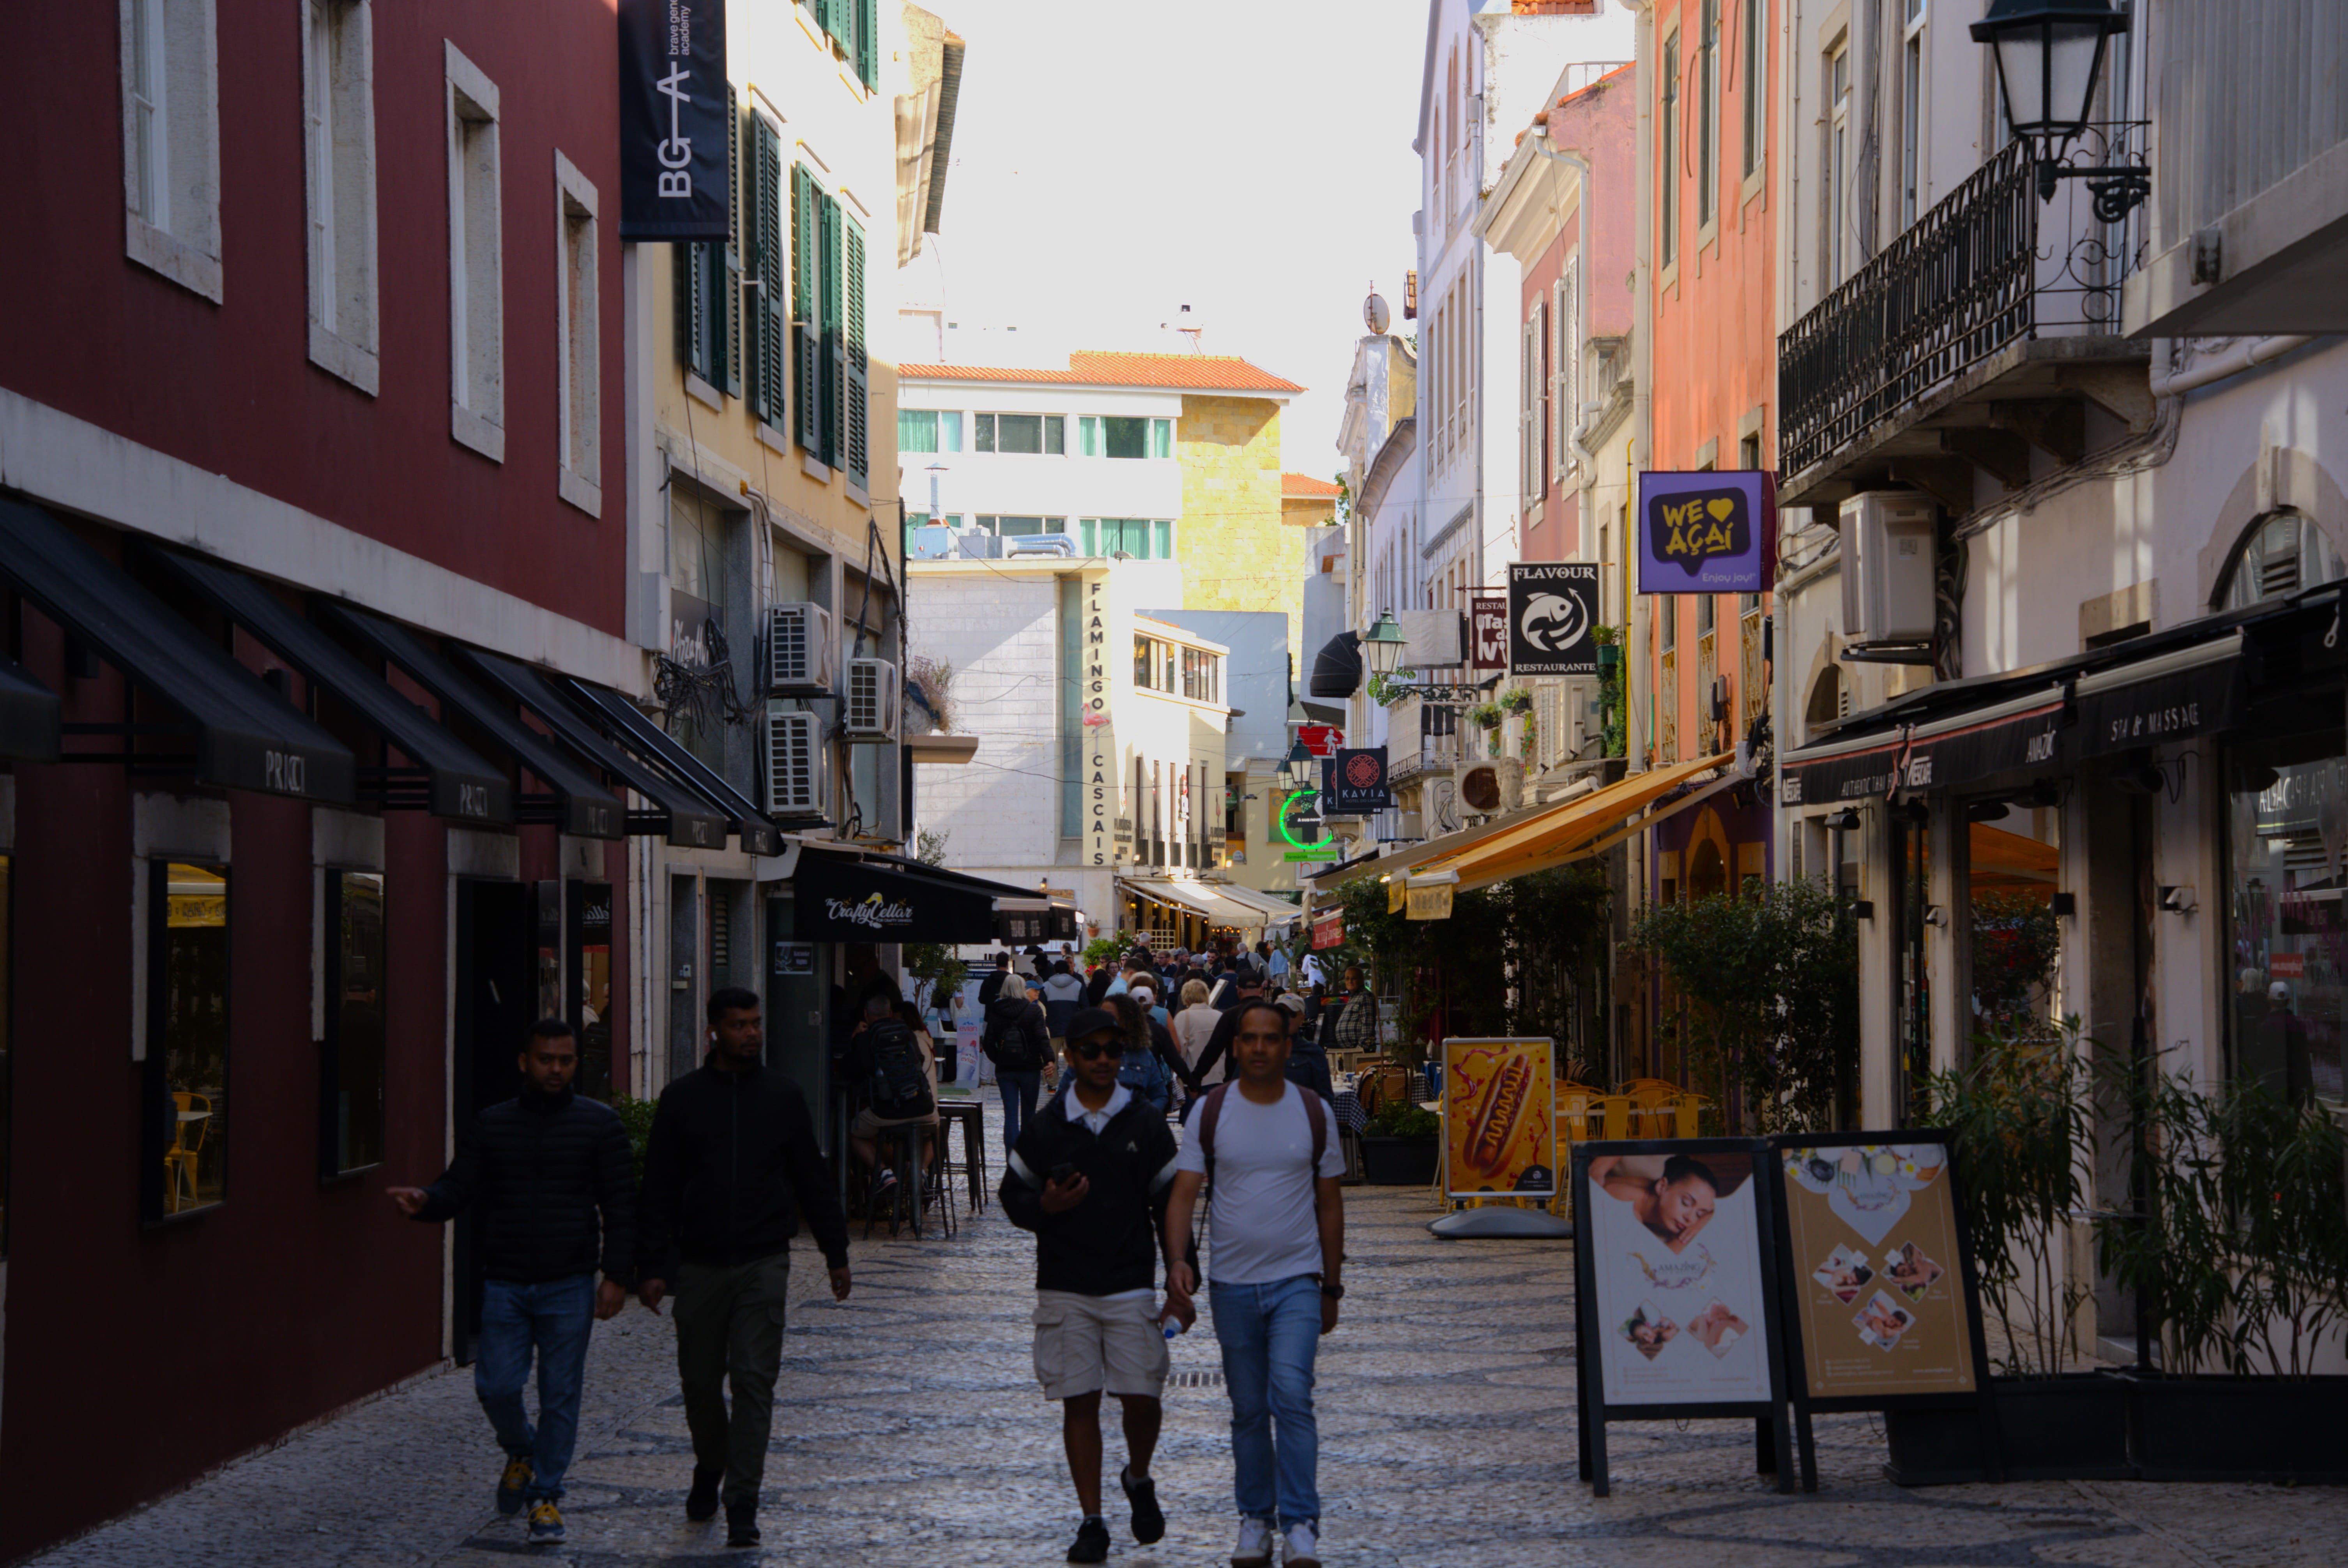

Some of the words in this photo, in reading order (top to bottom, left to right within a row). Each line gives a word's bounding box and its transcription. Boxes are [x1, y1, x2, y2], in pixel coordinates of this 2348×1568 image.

[668, 25, 679, 55] brave
[679, 5, 691, 55] academy
[1662, 499, 1704, 528] WE
[1666, 522, 1734, 556] AÇAÍ
[1513, 567, 1597, 582] FLAVOUR
[1702, 573, 1731, 583] Enjoy
[1091, 583, 1104, 710] FLAMINGO
[1515, 662, 1596, 673] RESTAURANTE
[1342, 789, 1385, 798] KAVIA
[1093, 755, 1104, 865] CASCAIS
[829, 901, 872, 925] Crafty
[870, 899, 913, 920] Cellar
[961, 1056, 976, 1065] evian
